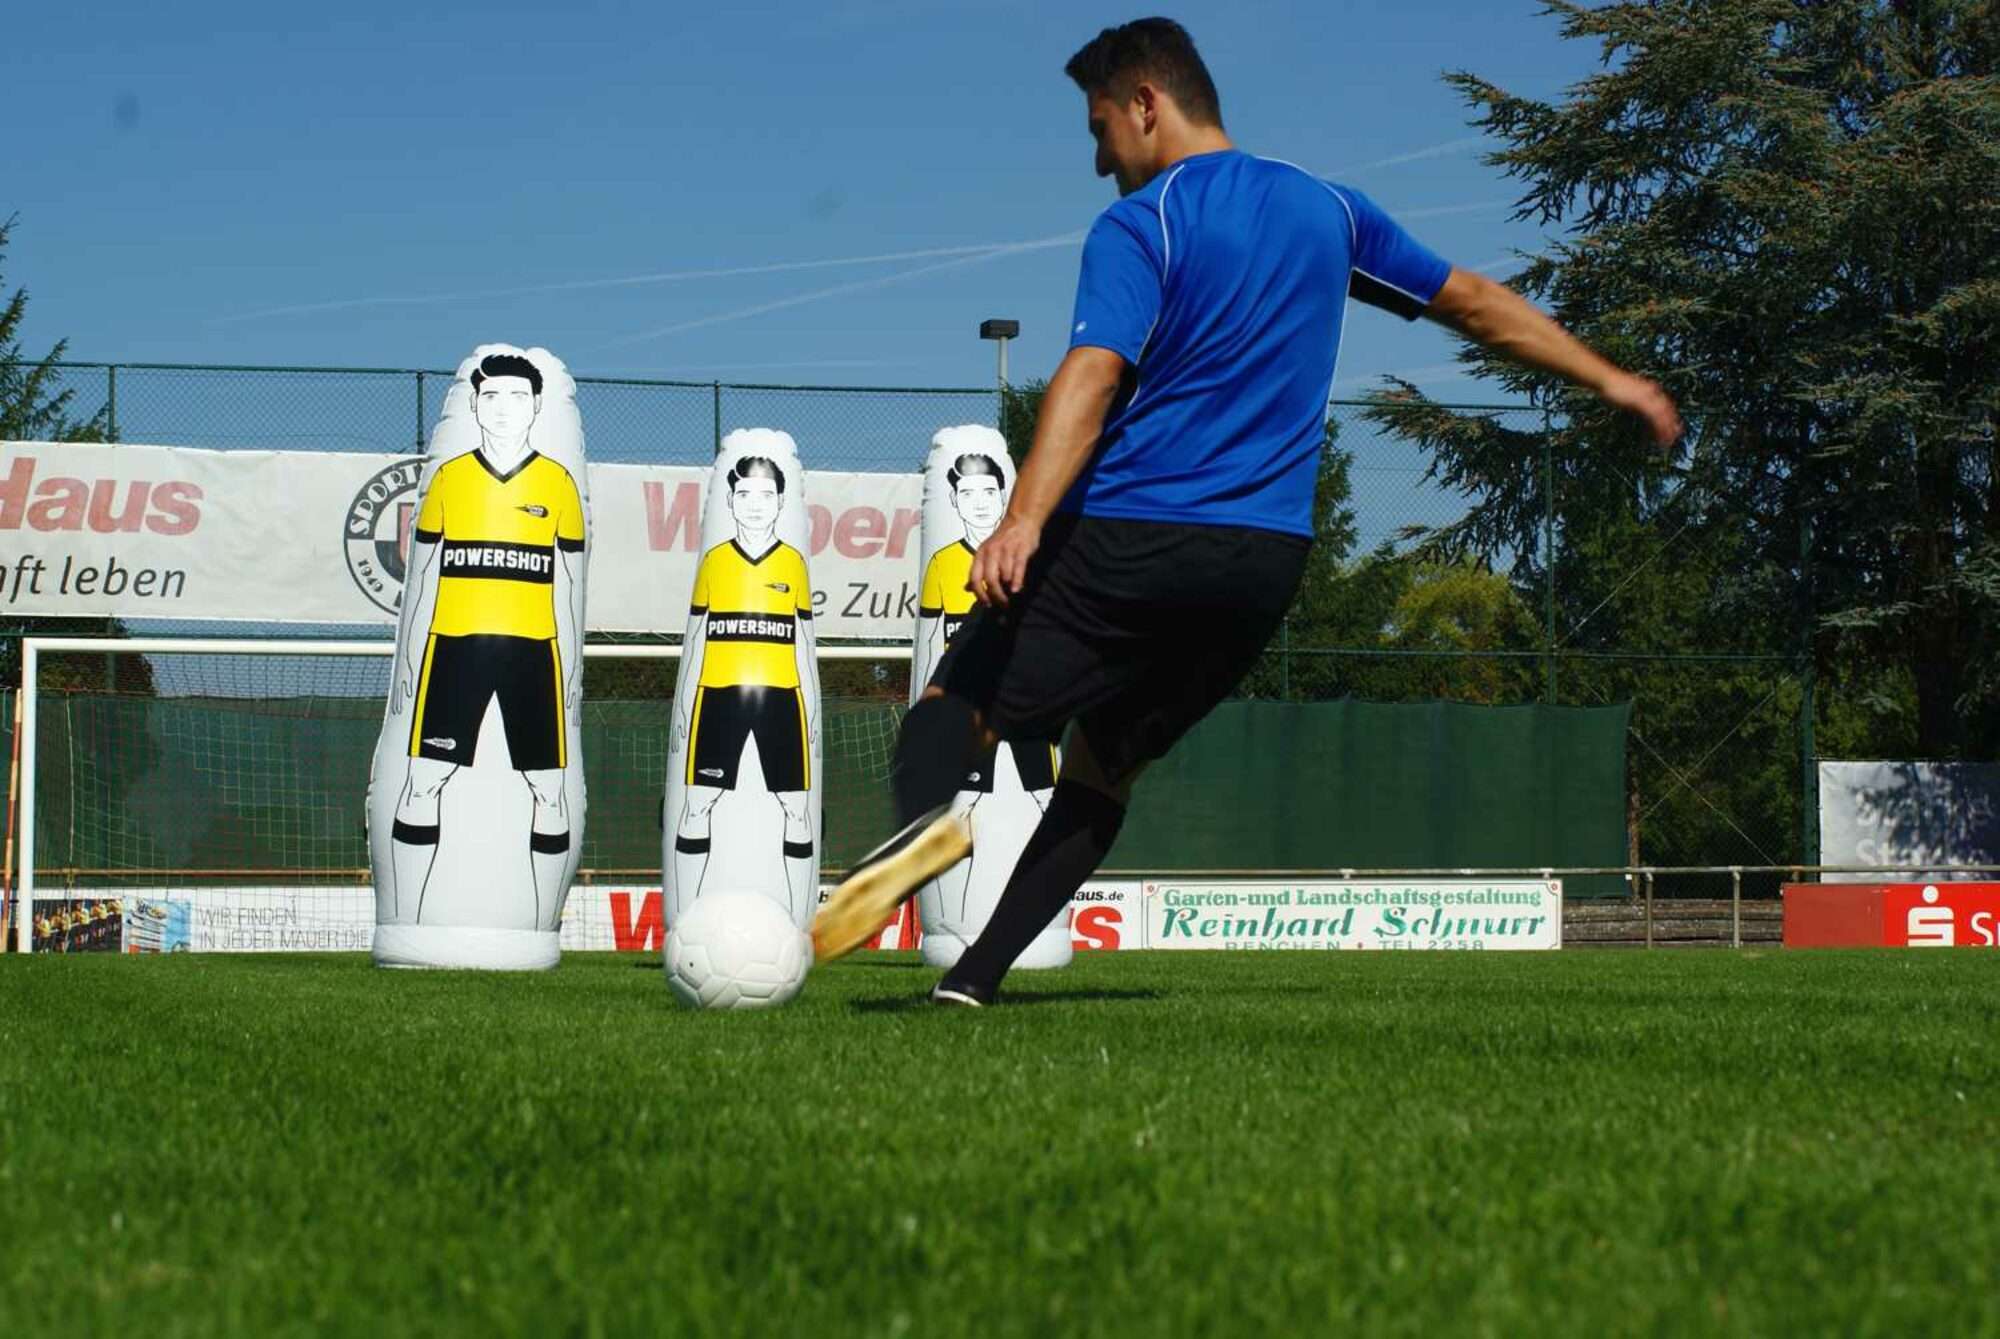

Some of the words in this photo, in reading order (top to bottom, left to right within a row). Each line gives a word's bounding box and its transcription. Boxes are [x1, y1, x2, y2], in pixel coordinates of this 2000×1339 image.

[350, 464, 418, 536] SPORT
[443, 548, 551, 574] POWERSHOT
[59, 555, 186, 598] leben
[358, 559, 384, 593] 1949
[841, 582, 917, 619] Zuk
[708, 620, 793, 639] POWERSHOT
[1071, 890, 1125, 901] aus.de
[1296, 888, 1542, 908] Landschaftsgestaltung
[200, 908, 232, 926] WIR
[238, 907, 297, 926] FINDEN
[1162, 907, 1354, 941] Reinhard
[1373, 907, 1546, 939] Schnurr
[200, 931, 216, 949] IN
[222, 930, 274, 949] JEDER
[279, 929, 338, 949] MAUER
[344, 929, 369, 948] DIE
